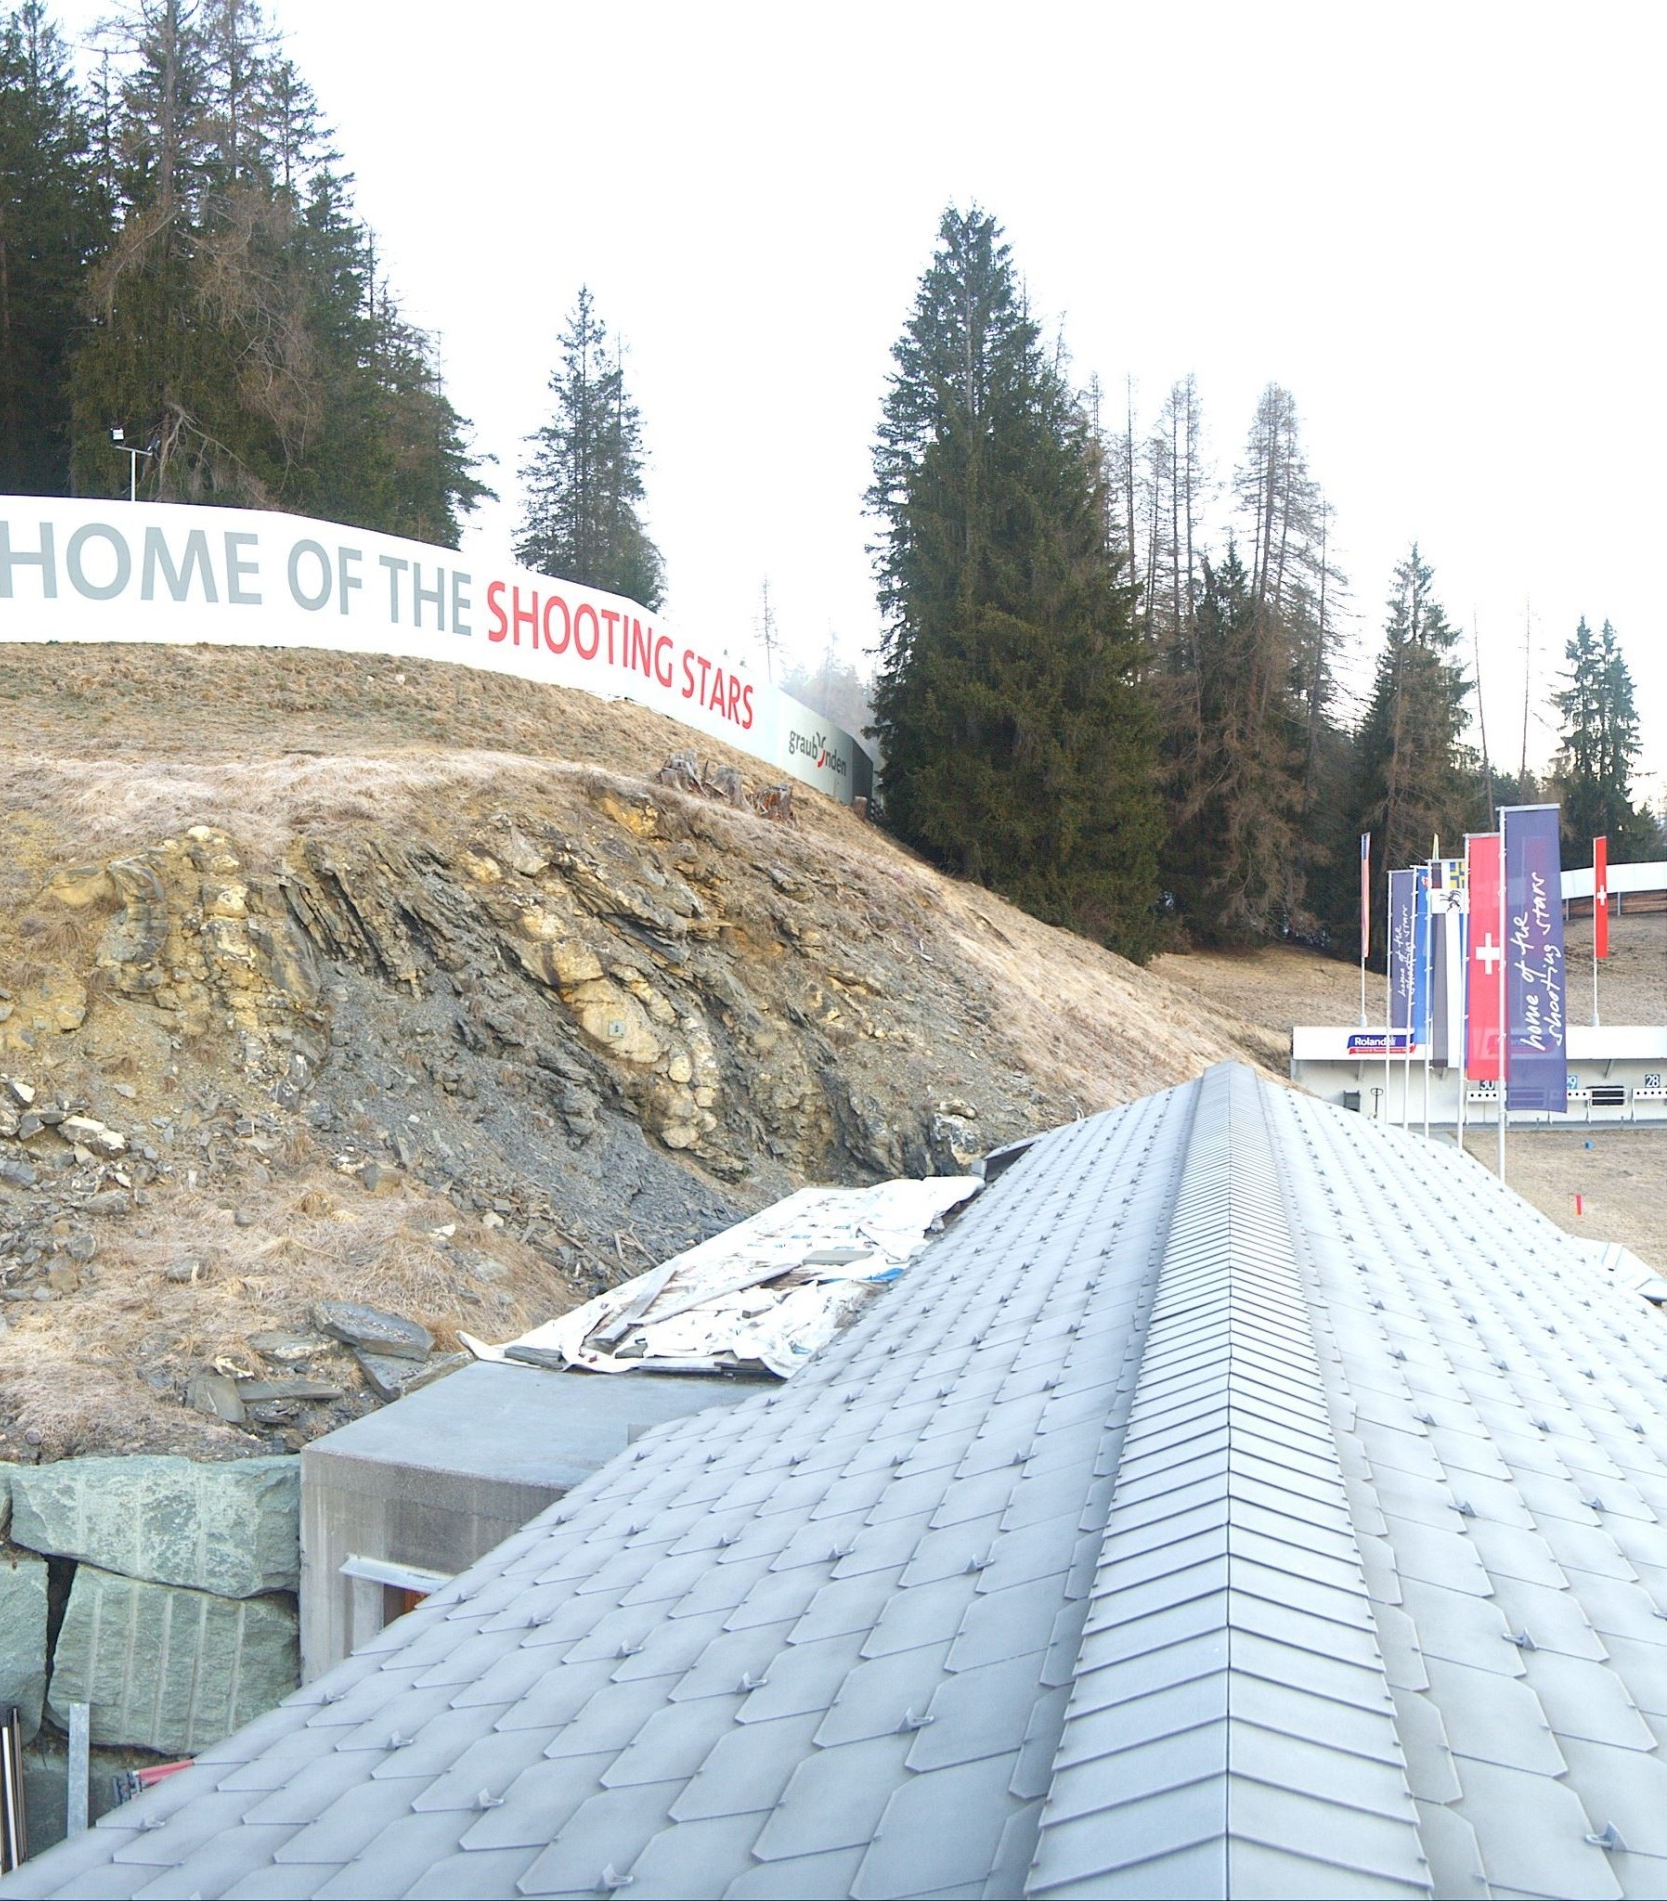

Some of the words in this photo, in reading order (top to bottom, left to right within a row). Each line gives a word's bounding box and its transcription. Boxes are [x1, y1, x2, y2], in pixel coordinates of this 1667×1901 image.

[287, 538, 363, 615] OF
[379, 554, 473, 637] THE
[486, 580, 673, 689] SHOOTING
[680, 648, 755, 731] STARS
[1520, 994, 1546, 1051] home
[1646, 1075, 1659, 1088] 28
